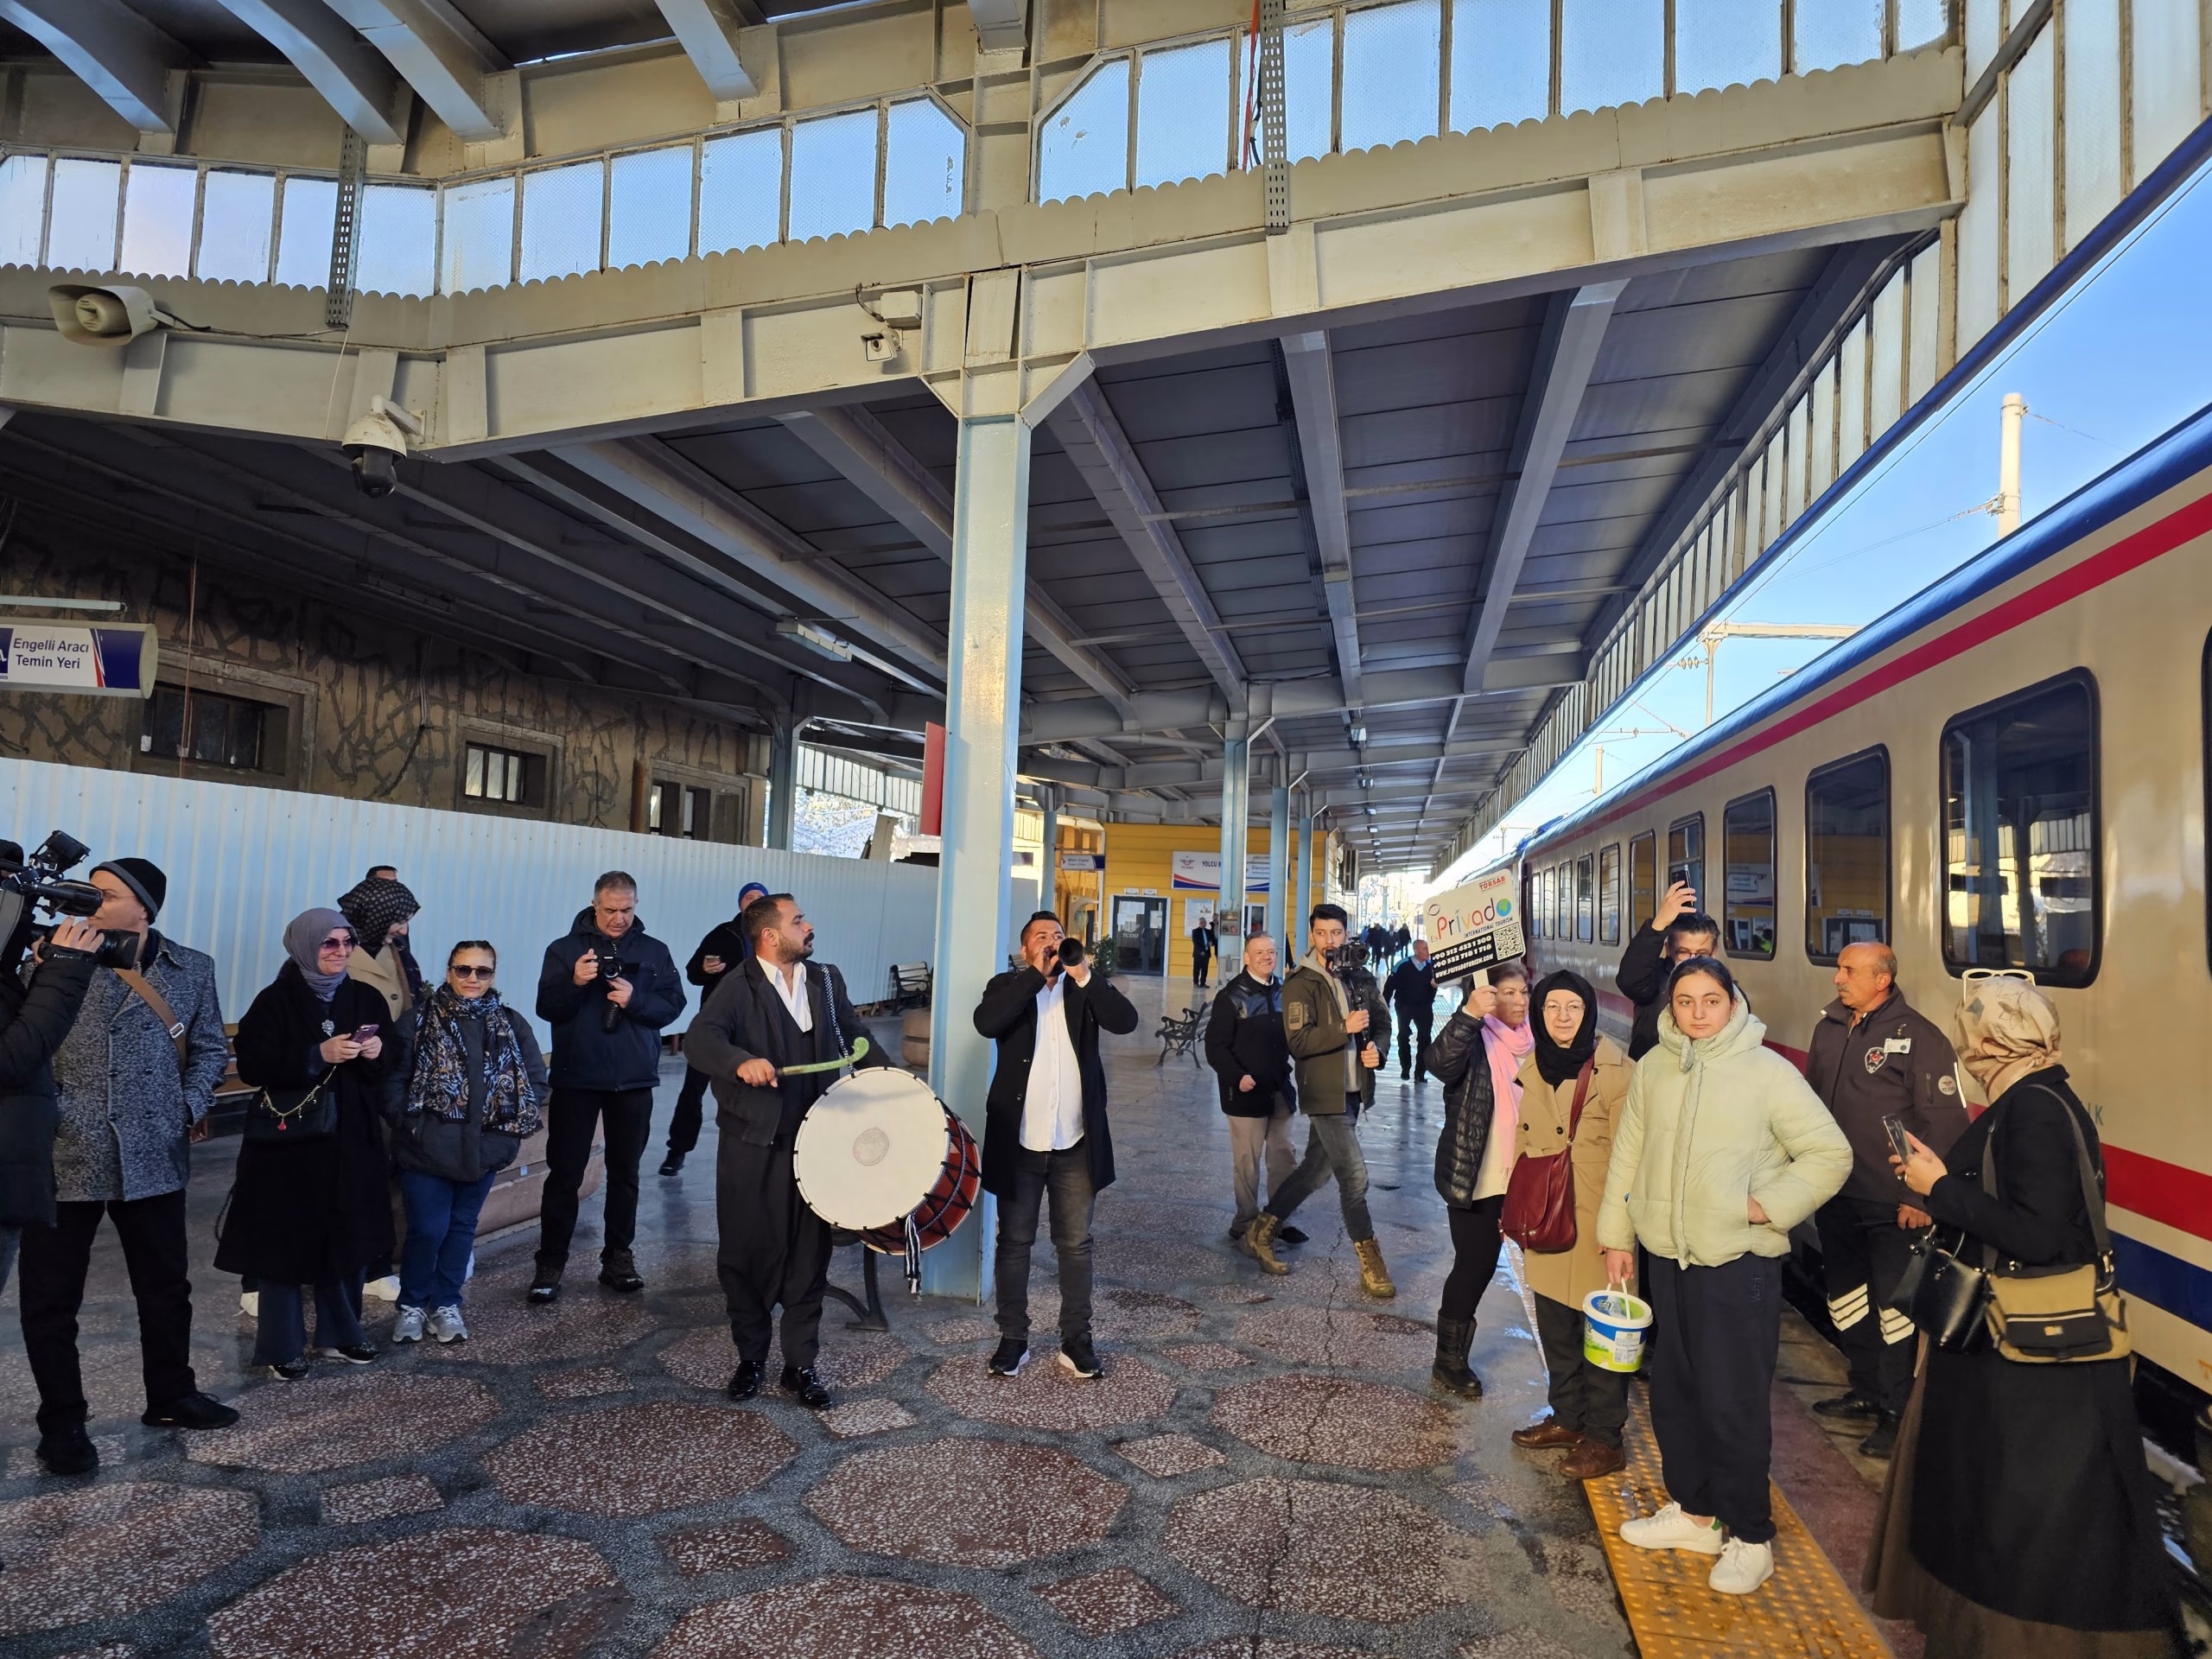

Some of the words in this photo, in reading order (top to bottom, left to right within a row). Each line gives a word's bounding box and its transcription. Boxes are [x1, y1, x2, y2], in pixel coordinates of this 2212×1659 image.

[13, 638, 55, 652] Engelli
[57, 640, 89, 652] Aracı
[16, 654, 53, 667] Temin
[57, 657, 80, 669] Yeri
[1479, 876, 1505, 890] TÜRSAB
[1465, 924, 1494, 938] INTERNATIONAL
[1496, 917, 1513, 927] TOURISM
[1477, 936, 1491, 944] 300
